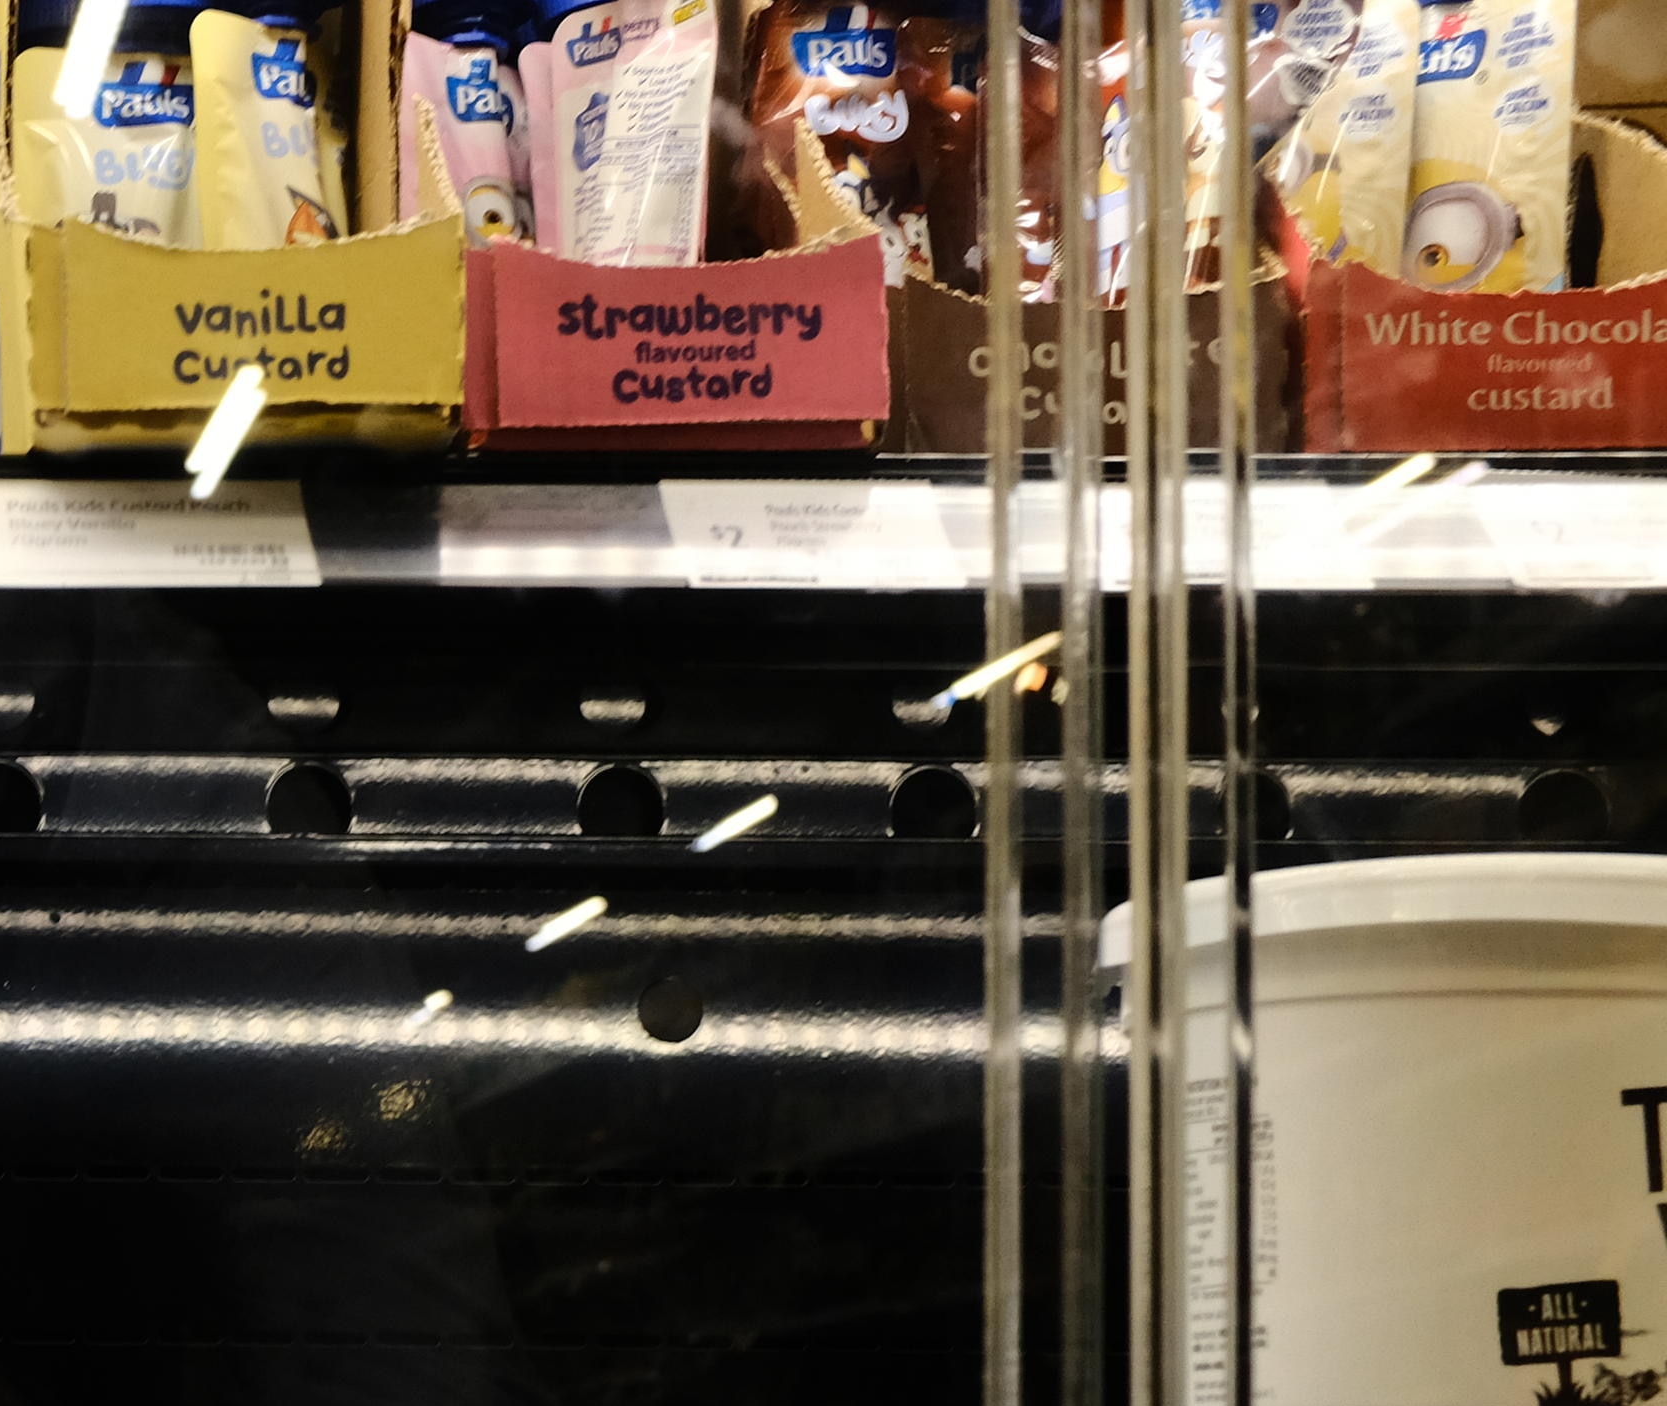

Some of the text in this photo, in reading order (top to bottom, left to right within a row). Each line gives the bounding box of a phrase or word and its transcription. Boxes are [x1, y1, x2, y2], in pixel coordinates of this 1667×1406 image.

[807, 34, 888, 69] Pauls
[101, 87, 190, 119] Pauls
[175, 288, 346, 338] vanilla
[557, 294, 823, 340] strawberry
[1364, 309, 1493, 346] White
[635, 340, 757, 363] flavoured
[1466, 376, 1615, 411] custard
[1541, 1292, 1579, 1321] ALL
[1516, 1322, 1607, 1357] NATURAL
